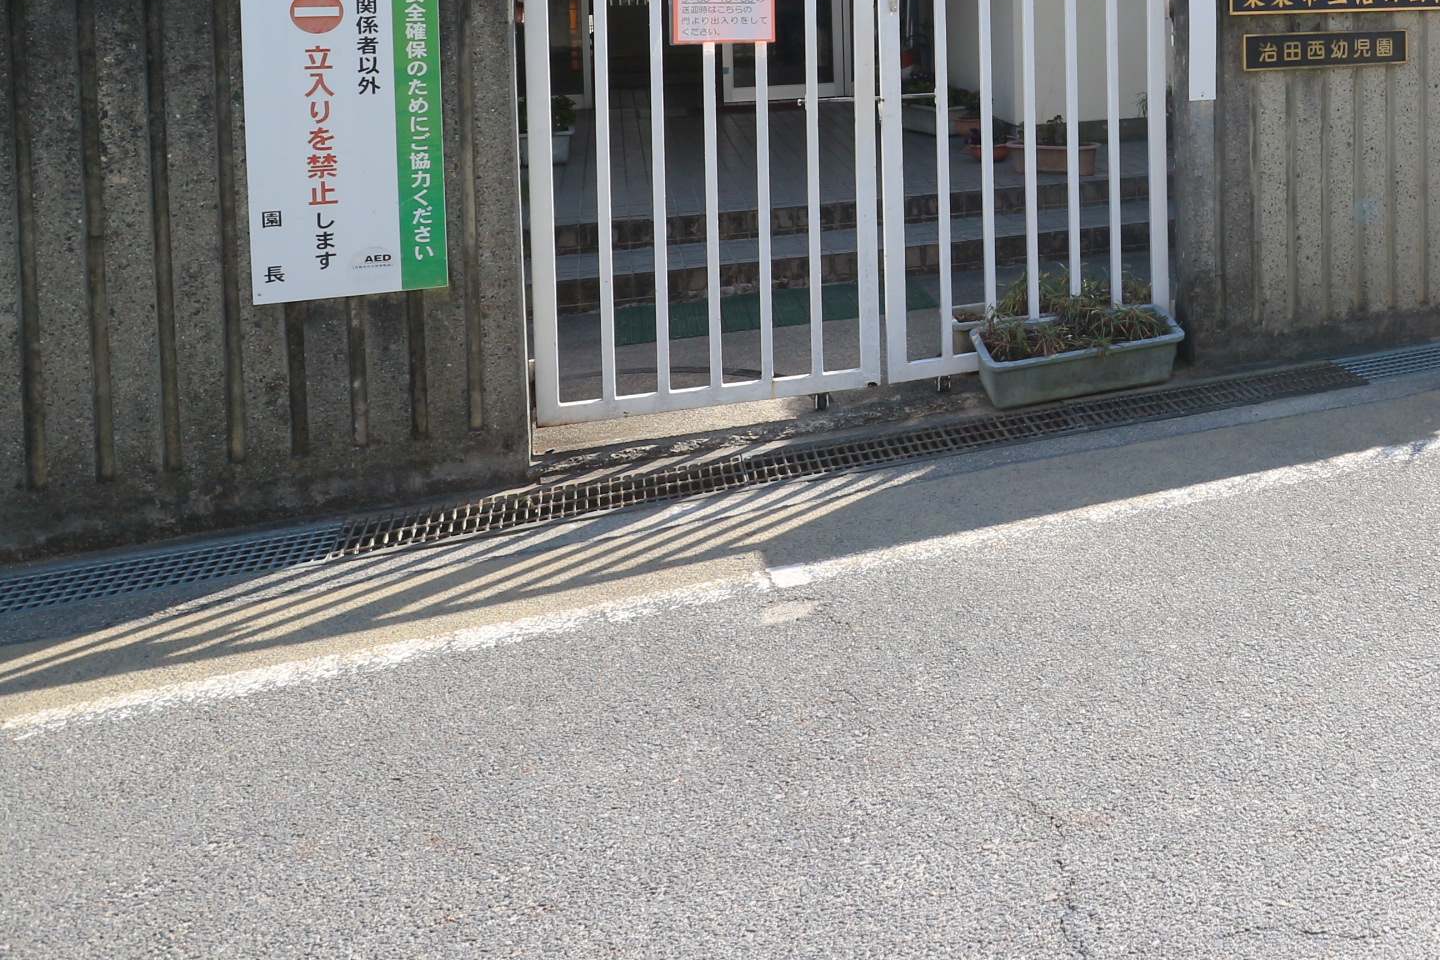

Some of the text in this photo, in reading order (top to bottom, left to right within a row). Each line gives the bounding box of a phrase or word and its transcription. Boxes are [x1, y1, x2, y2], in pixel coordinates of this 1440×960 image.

[681, 5, 752, 14] 送迎時はこちらの
[681, 16, 768, 25] 門より出入りをして
[1258, 38, 1393, 63] 治田西幼児園
[304, 45, 338, 270] 立入りを禁止します
[364, 254, 392, 262] AED
